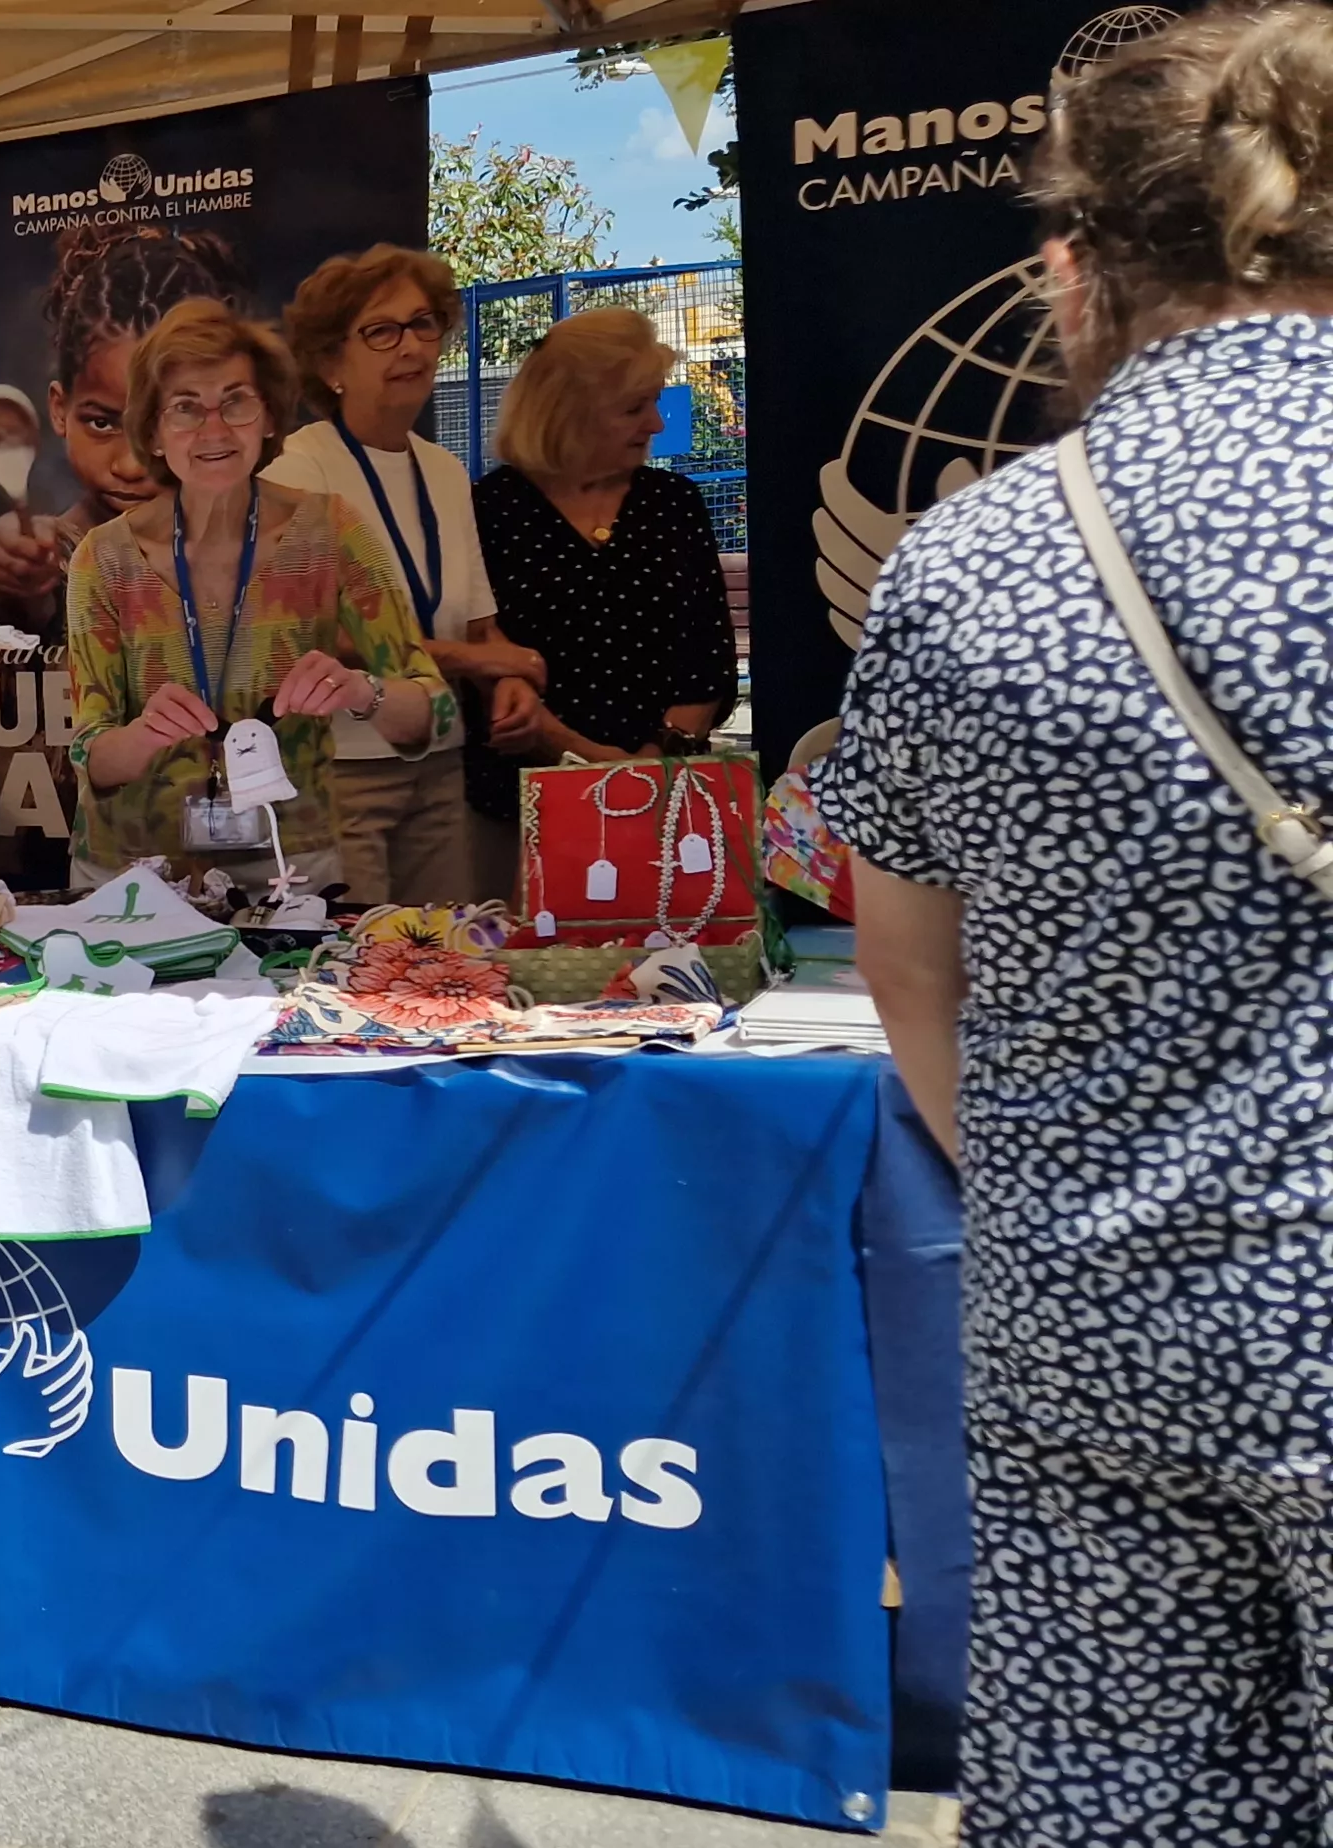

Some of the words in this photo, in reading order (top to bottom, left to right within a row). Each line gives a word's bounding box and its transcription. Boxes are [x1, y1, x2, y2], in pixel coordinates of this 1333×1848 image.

[793, 94, 1047, 166] Manos
[12, 188, 99, 216] Manos
[153, 167, 254, 197] Unidas
[798, 150, 1021, 211] CAMPAÑA
[14, 211, 91, 237] CAMPAÑA
[94, 204, 161, 227] CONTRA
[165, 202, 181, 218] EL
[185, 191, 252, 216] HAMBRE
[111, 1366, 703, 1531] Unidas
